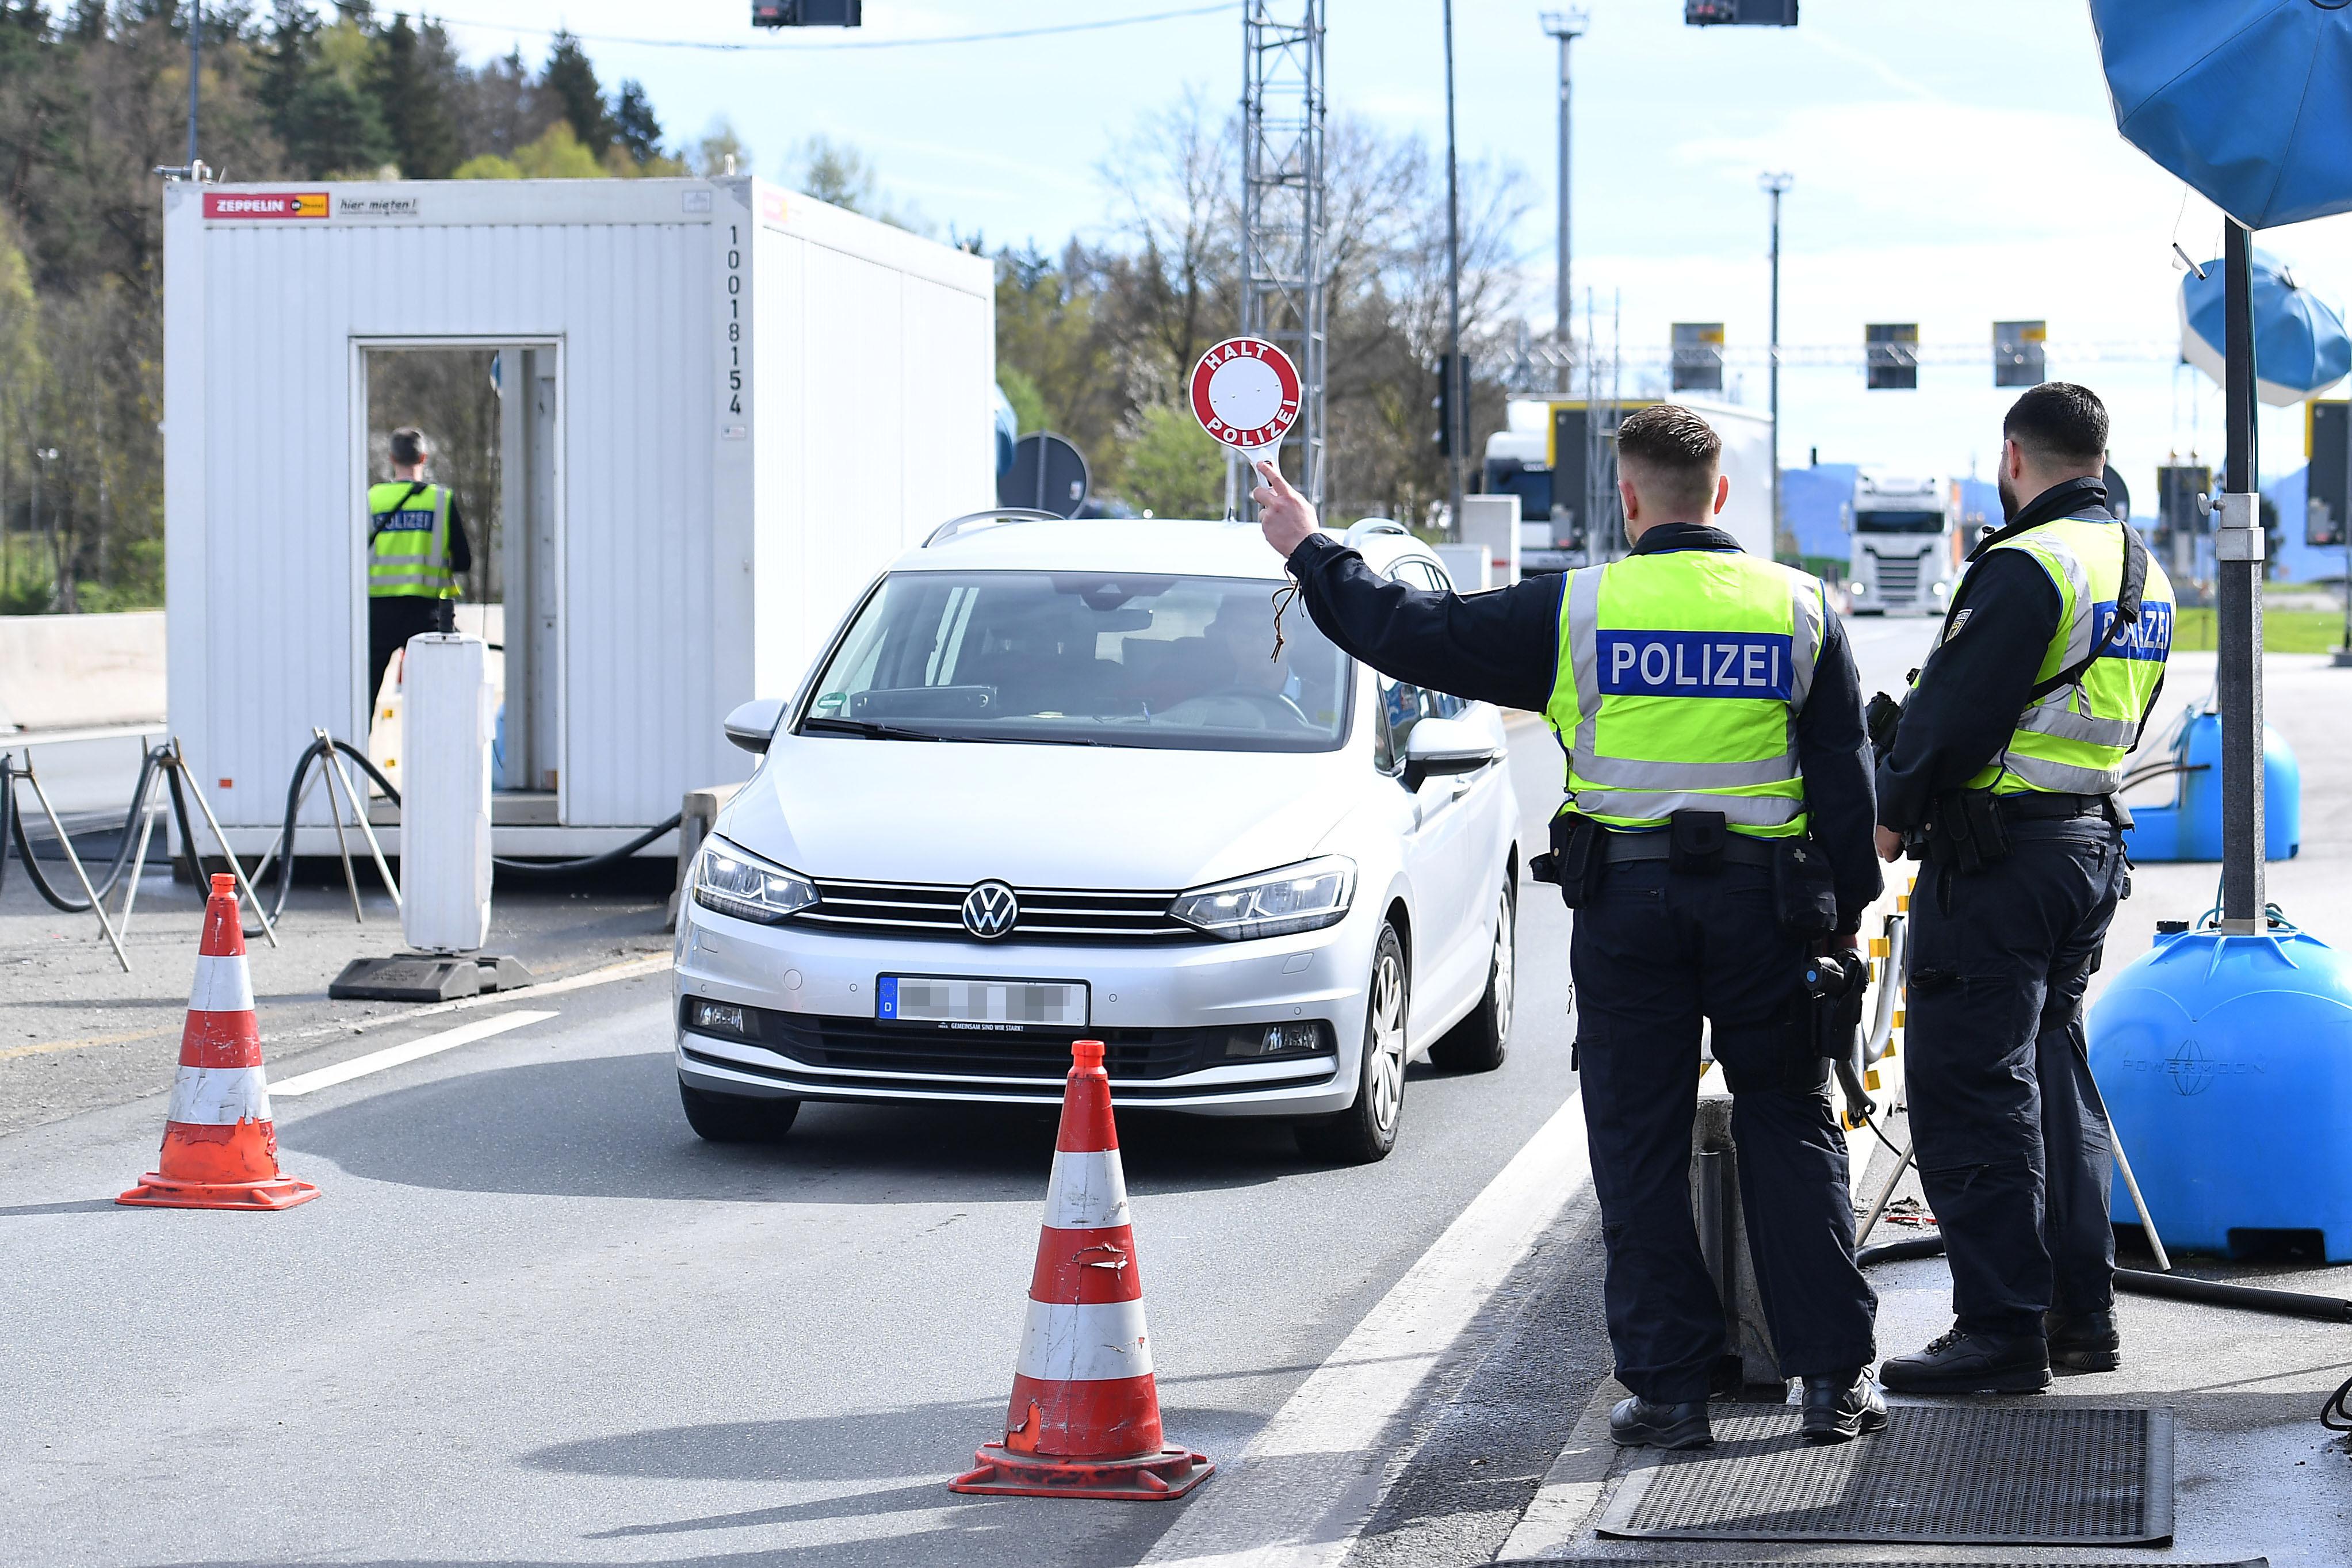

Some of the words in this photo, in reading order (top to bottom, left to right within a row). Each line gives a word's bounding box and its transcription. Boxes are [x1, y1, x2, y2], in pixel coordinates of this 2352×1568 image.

[216, 199, 284, 212] ZEPPELIN
[341, 199, 364, 209] hier
[727, 225, 741, 415] 10018154
[1204, 342, 1268, 370] HALT
[1207, 399, 1297, 445] POLIZEI
[1612, 642, 1779, 687] POLIZEI
[884, 1002, 892, 1012] D
[2122, 1060, 2265, 1074] POWERMOON
